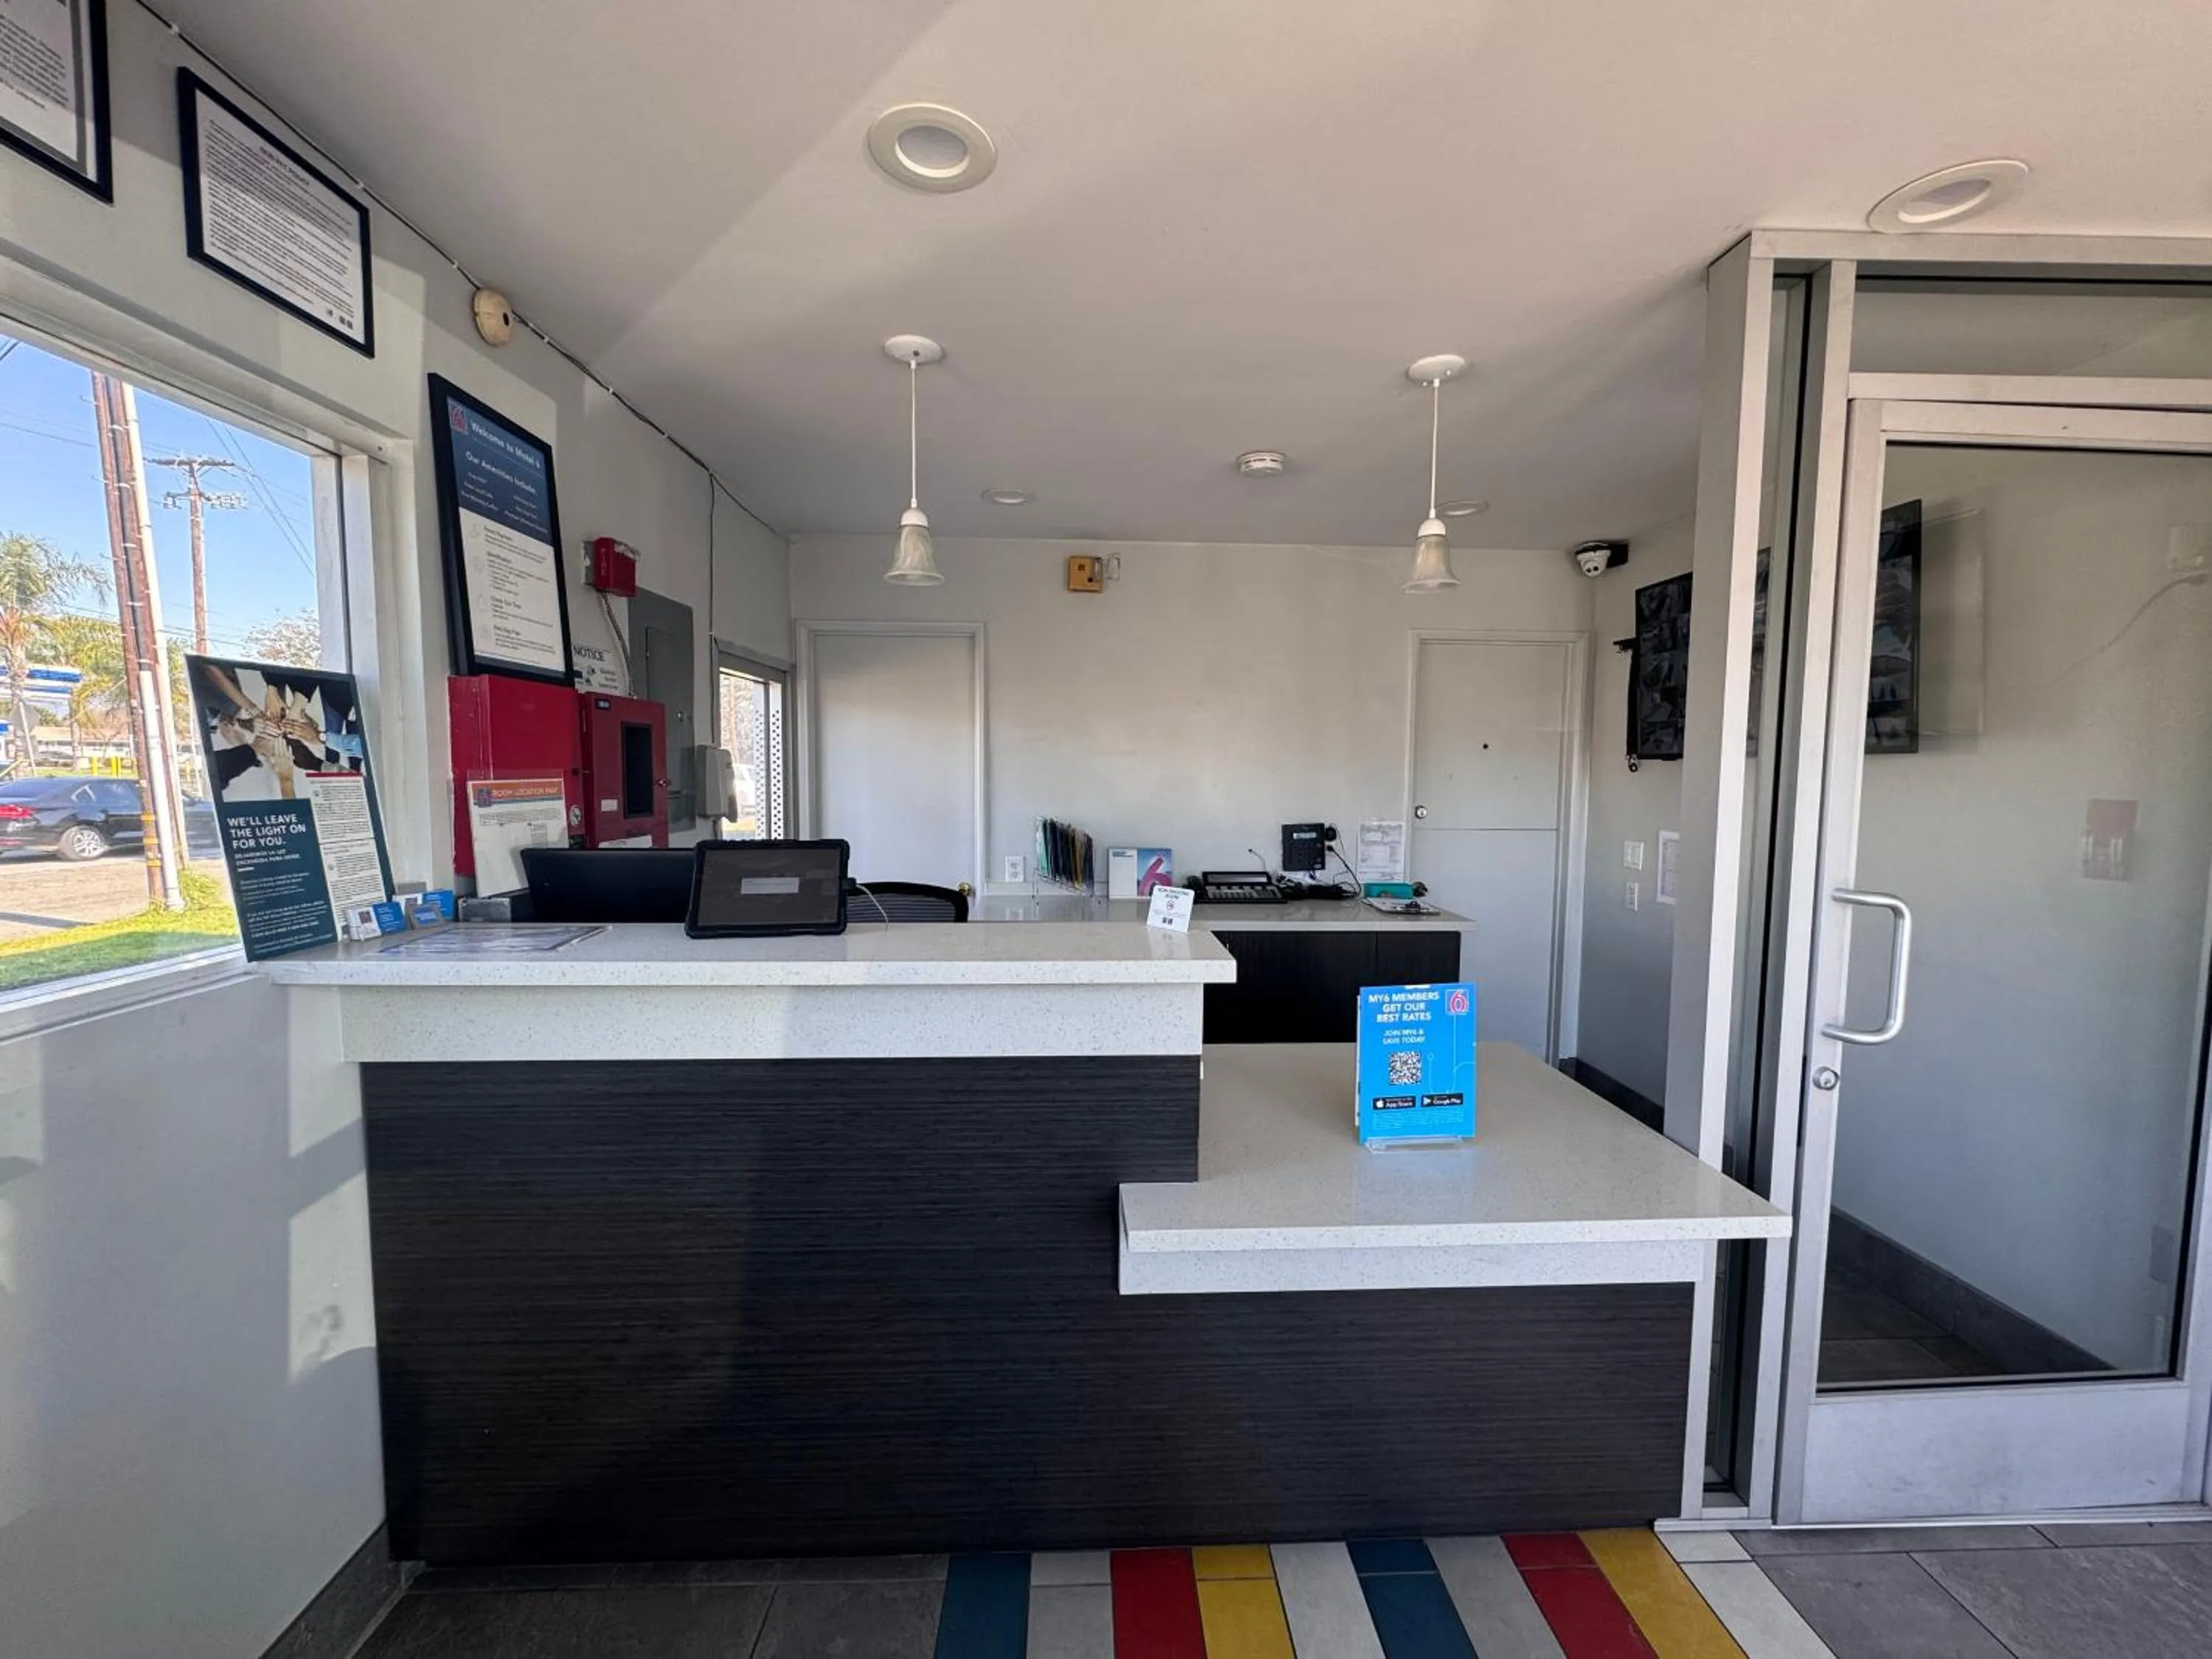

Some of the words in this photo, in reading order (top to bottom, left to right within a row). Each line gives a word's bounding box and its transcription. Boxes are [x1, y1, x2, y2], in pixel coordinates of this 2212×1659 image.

[470, 418, 506, 448] Welcome
[505, 442, 515, 454] to
[515, 447, 535, 466] Motel
[465, 450, 479, 465] Our
[573, 644, 606, 662] NOTICE
[492, 789, 513, 797] ROOM
[514, 787, 544, 796] LOCATION
[227, 816, 262, 827] WE'LL
[265, 813, 298, 825] LEAVE
[229, 828, 253, 838] THE
[255, 825, 287, 836] LIGHT
[290, 824, 306, 834] ON
[232, 838, 256, 849] FOR
[259, 835, 287, 847] YOU.
[1368, 994, 1390, 1004] MY6
[1392, 991, 1440, 1002] MEMBERS
[1382, 1004, 1402, 1012] GET
[1404, 1002, 1425, 1012] OUR
[1377, 1013, 1400, 1023] BEST
[1402, 1012, 1432, 1022] RATES
[1382, 1037, 1400, 1045] SAVE
